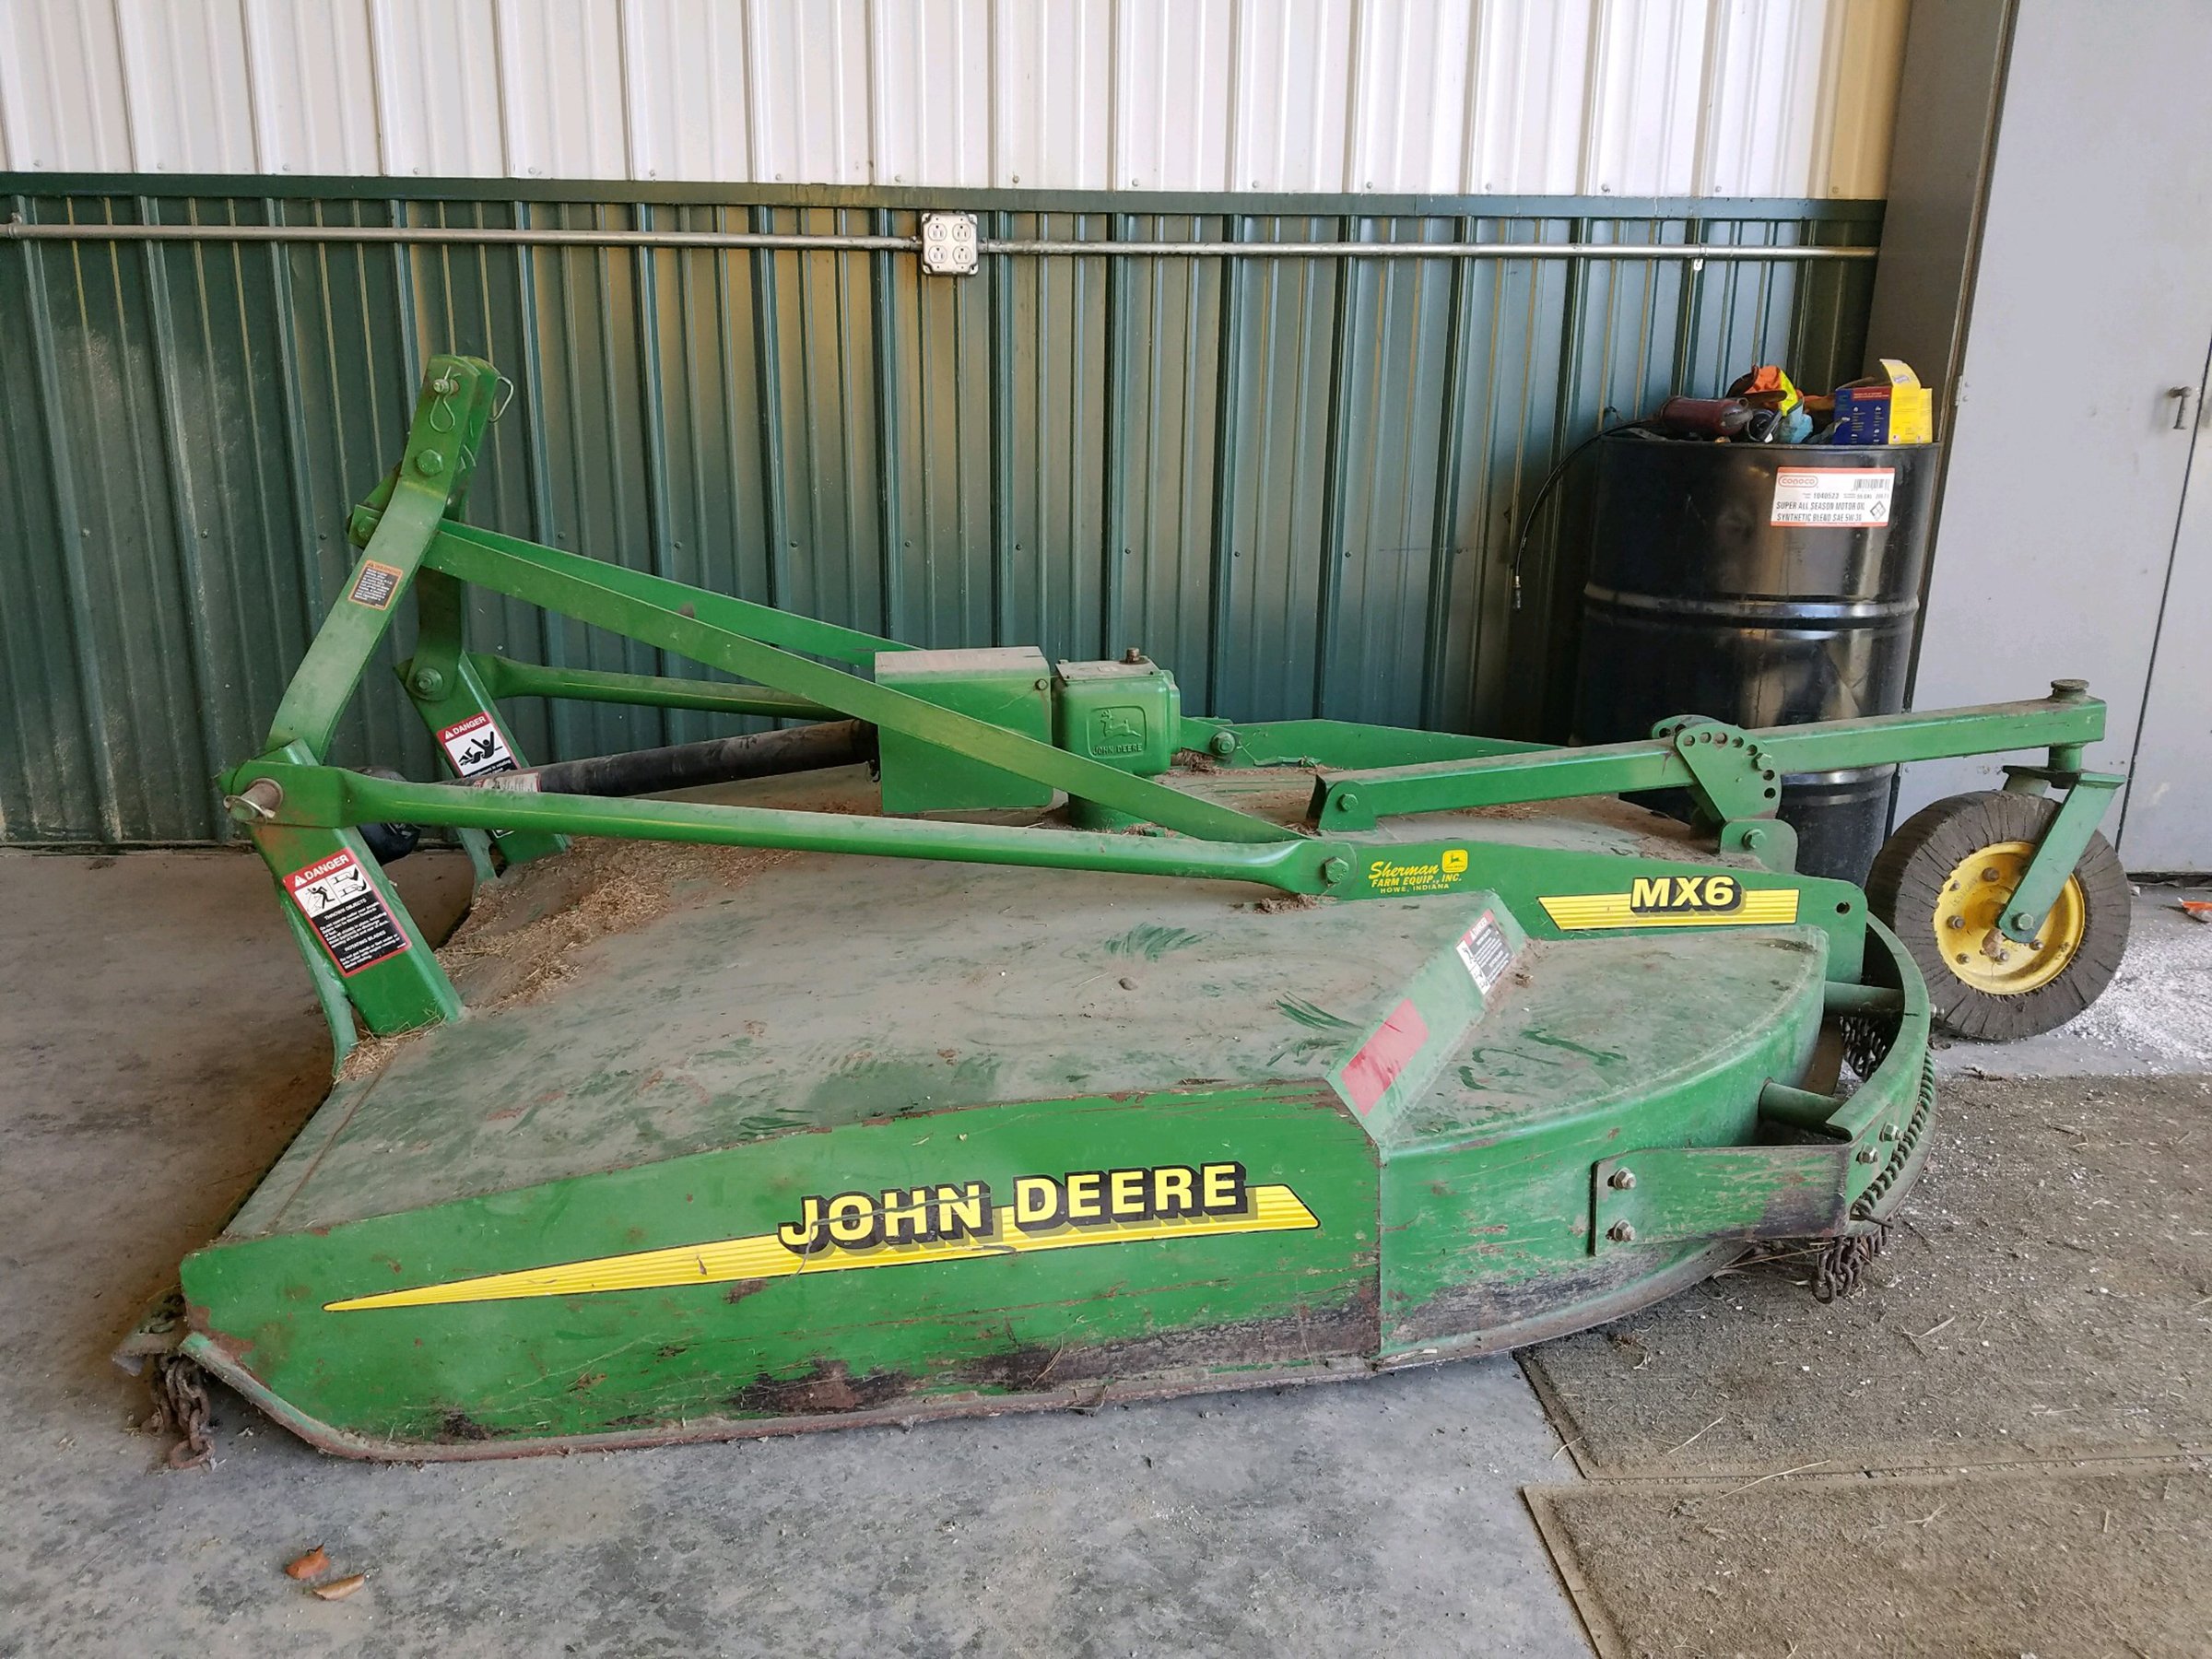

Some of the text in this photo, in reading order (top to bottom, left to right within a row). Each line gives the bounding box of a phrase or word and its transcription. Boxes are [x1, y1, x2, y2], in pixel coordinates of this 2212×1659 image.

[1776, 501, 1865, 511] SUPER ALL SEASON MOTOR OIL
[1777, 513, 1812, 522] SYNTHETIC
[1812, 513, 1831, 522] BLEND
[1832, 513, 1844, 522] SAE
[453, 715, 487, 735] DANGER
[1092, 743, 1143, 756] JOHN DEERE
[303, 853, 350, 881] DANGER
[1368, 861, 1440, 879] Sherman
[1371, 877, 1400, 888] FARM
[1441, 873, 1462, 882] INC.
[1413, 883, 1450, 891] INDIANA
[1630, 876, 1739, 912] MX6
[779, 1163, 1243, 1251] JOHN DEERE
